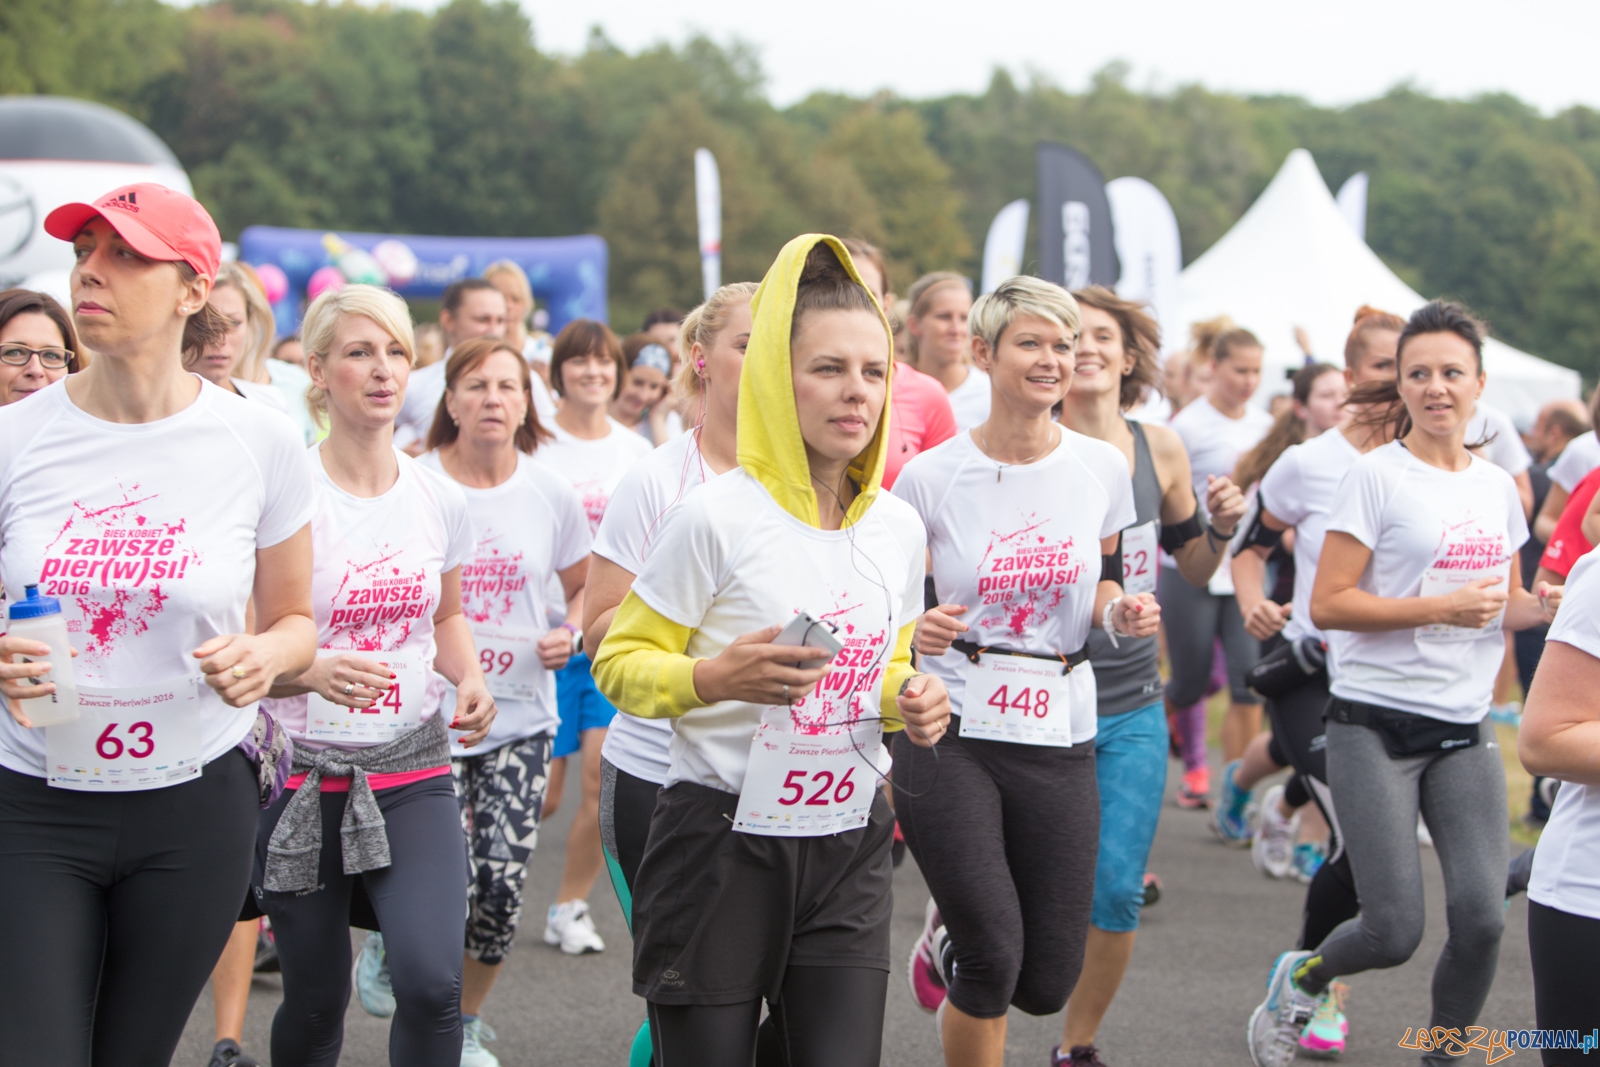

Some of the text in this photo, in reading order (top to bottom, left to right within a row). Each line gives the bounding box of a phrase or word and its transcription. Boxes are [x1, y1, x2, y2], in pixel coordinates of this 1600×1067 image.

[101, 198, 139, 213] adidas
[103, 529, 164, 538] BIEG KOBIET
[64, 538, 175, 557] zawsze
[1016, 547, 1032, 555] BIEG
[1446, 543, 1504, 557] zawsze
[461, 563, 518, 577] awsze
[990, 551, 1069, 573] zawsze
[39, 555, 189, 588] pier(w)si!
[45, 580, 91, 596] 2016
[372, 577, 414, 587] BIEG KOBIET
[461, 574, 527, 598] er(w)si!
[977, 564, 1080, 597] pier(w)si!
[346, 585, 423, 605] zawsze
[983, 591, 1014, 605] 2016
[328, 598, 430, 628] pier(w)si!
[332, 622, 365, 636] 26
[843, 637, 867, 648] OBIET
[827, 648, 874, 668] sze
[78, 692, 174, 708] Zawsze Pier(w)si 2016
[987, 684, 1050, 719] 448
[95, 721, 155, 760] 63
[788, 746, 819, 756] Zawsze
[777, 766, 856, 807] 526
